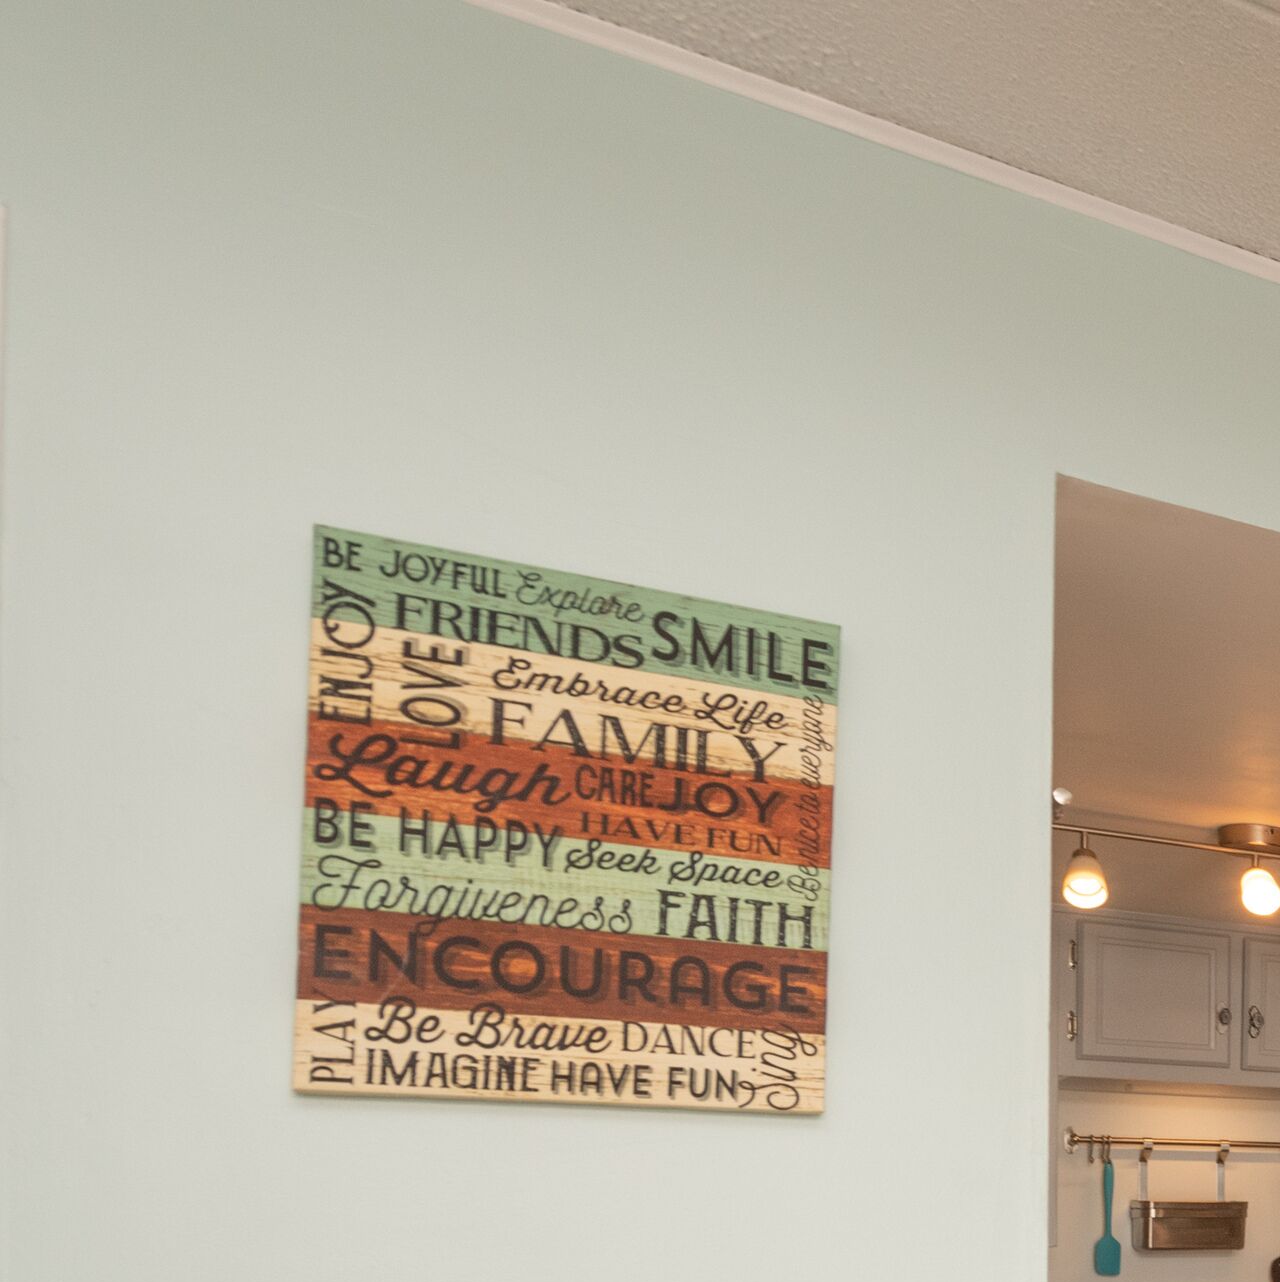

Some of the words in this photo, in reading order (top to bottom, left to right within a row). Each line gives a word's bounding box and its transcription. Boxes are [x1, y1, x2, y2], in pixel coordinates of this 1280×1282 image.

[321, 536, 363, 572] BE
[379, 548, 507, 599] JOYFUL
[514, 571, 645, 624] Explore
[318, 579, 378, 727] ENJOY
[391, 591, 645, 670] FRIENDS
[651, 610, 834, 690] SMILE
[400, 638, 467, 750] LOVE
[491, 656, 686, 714] Embrace
[695, 691, 790, 735] Life
[313, 733, 572, 813] Laugh
[486, 696, 787, 785] FAMILY
[799, 694, 834, 790] everyone
[574, 764, 655, 808] CARE
[658, 777, 783, 824] JOY
[313, 796, 373, 848] BE
[399, 806, 561, 867] HAPPY
[565, 838, 662, 875] Seek
[668, 850, 785, 888] Space
[580, 811, 695, 845] HAVE
[706, 827, 782, 857] FUN
[312, 854, 632, 937] Forgiveness
[787, 863, 821, 901] Be
[656, 888, 815, 949] FAITH
[314, 924, 812, 1014] ENCOURAGE
[309, 988, 356, 1085] PLAY
[364, 995, 446, 1044] Be
[455, 1001, 612, 1053] Brave
[621, 1021, 756, 1059] DANCE
[365, 1048, 540, 1092] IMAGINE
[551, 1060, 650, 1097] HAVE
[668, 1066, 737, 1099] FUN
[738, 1023, 818, 1111] Sing
